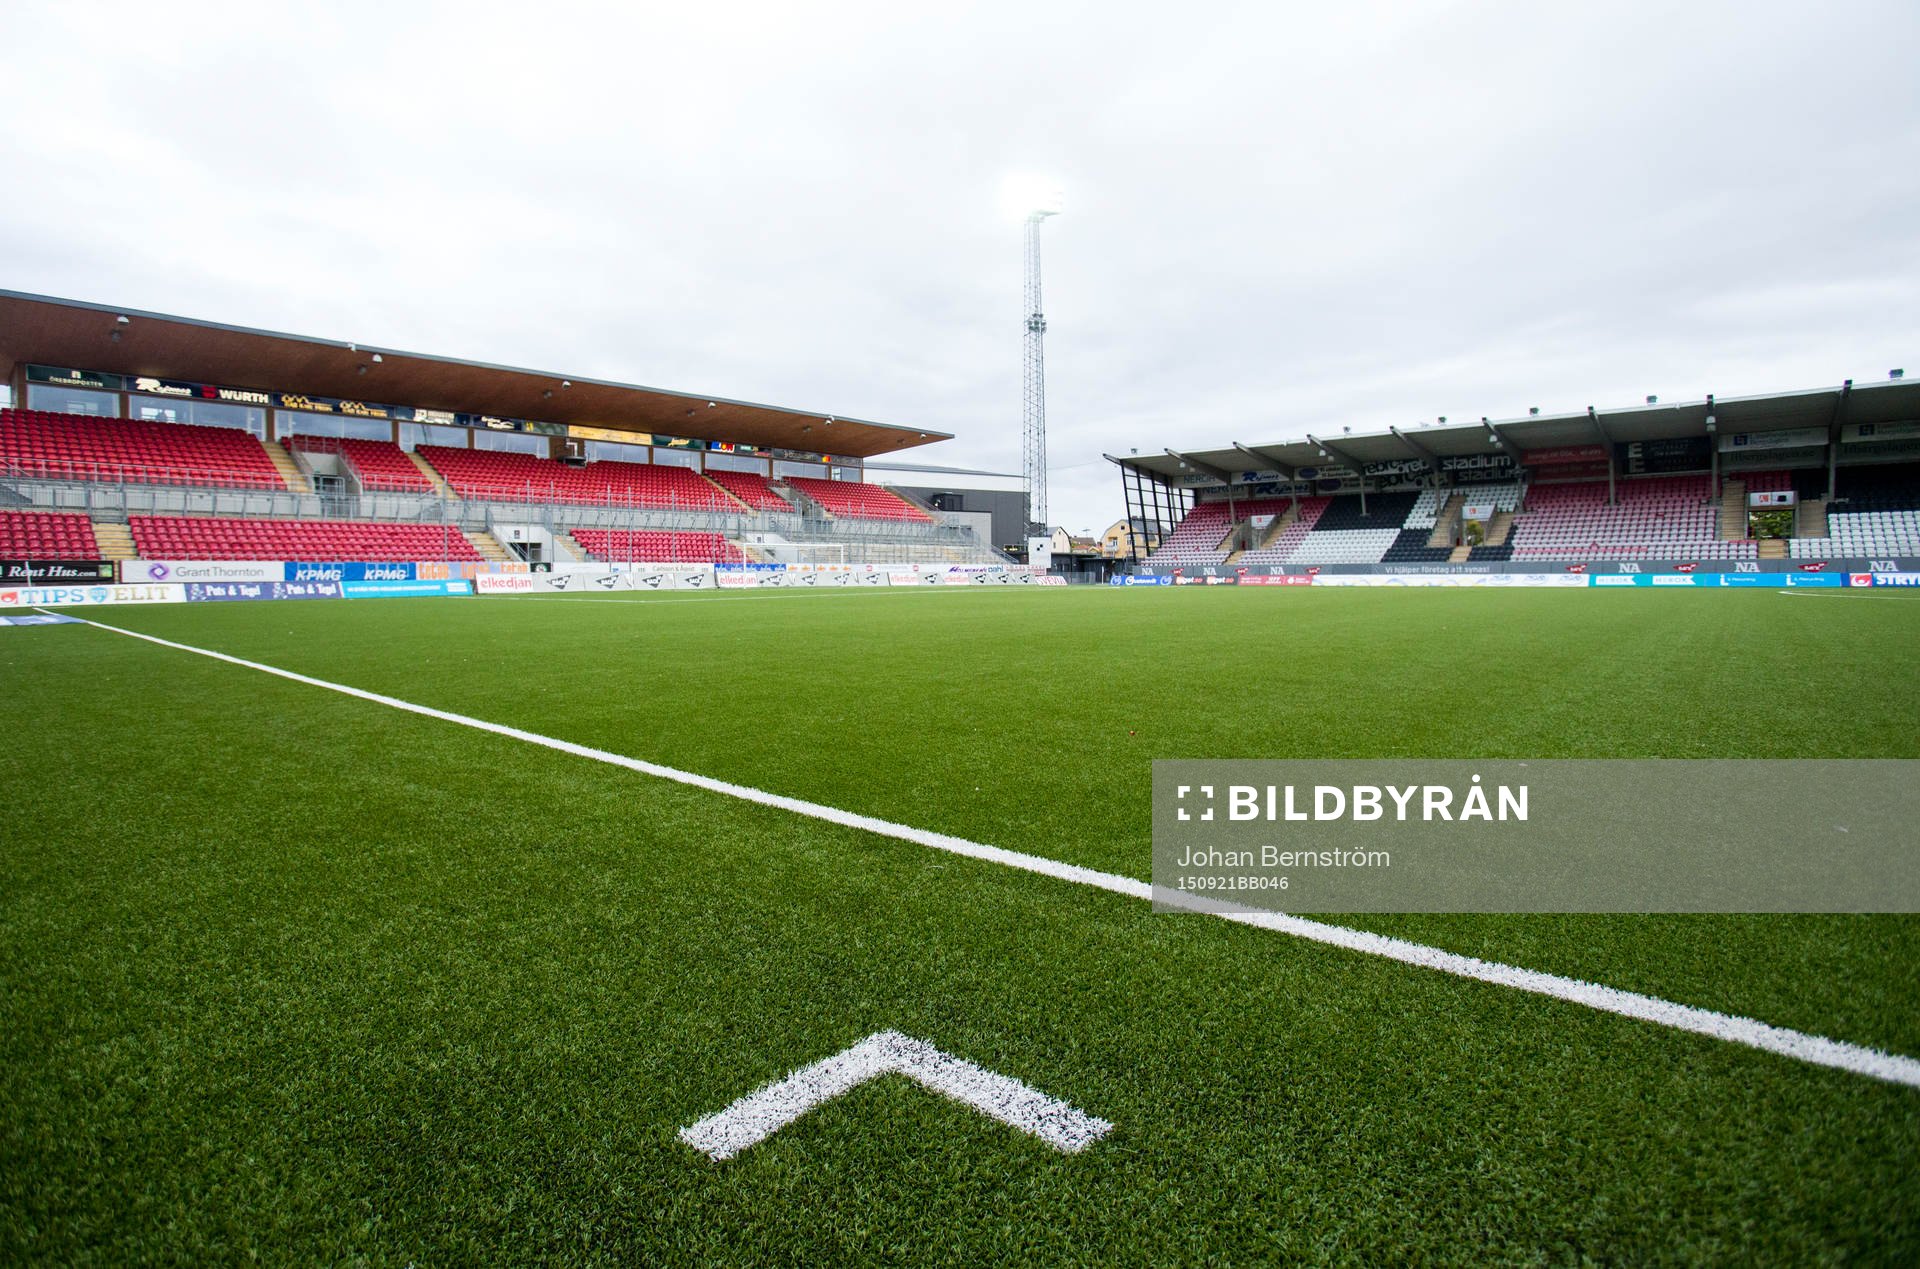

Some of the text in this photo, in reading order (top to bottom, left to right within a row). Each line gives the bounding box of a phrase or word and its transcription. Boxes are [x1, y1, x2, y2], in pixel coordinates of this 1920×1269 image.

[1442, 454, 1511, 471] stadium
[176, 566, 264, 577] Grant Thornton
[1141, 567, 1154, 576] NA
[1203, 567, 1217, 576] NA
[1270, 566, 1285, 575] NA
[1618, 562, 1642, 573] NA
[1734, 561, 1761, 573] NA
[1868, 560, 1899, 572] NA
[295, 569, 341, 581] KPMG
[364, 569, 407, 581] KPMG
[481, 576, 532, 590] elkedjan
[21, 587, 170, 604] TIPS ELIT
